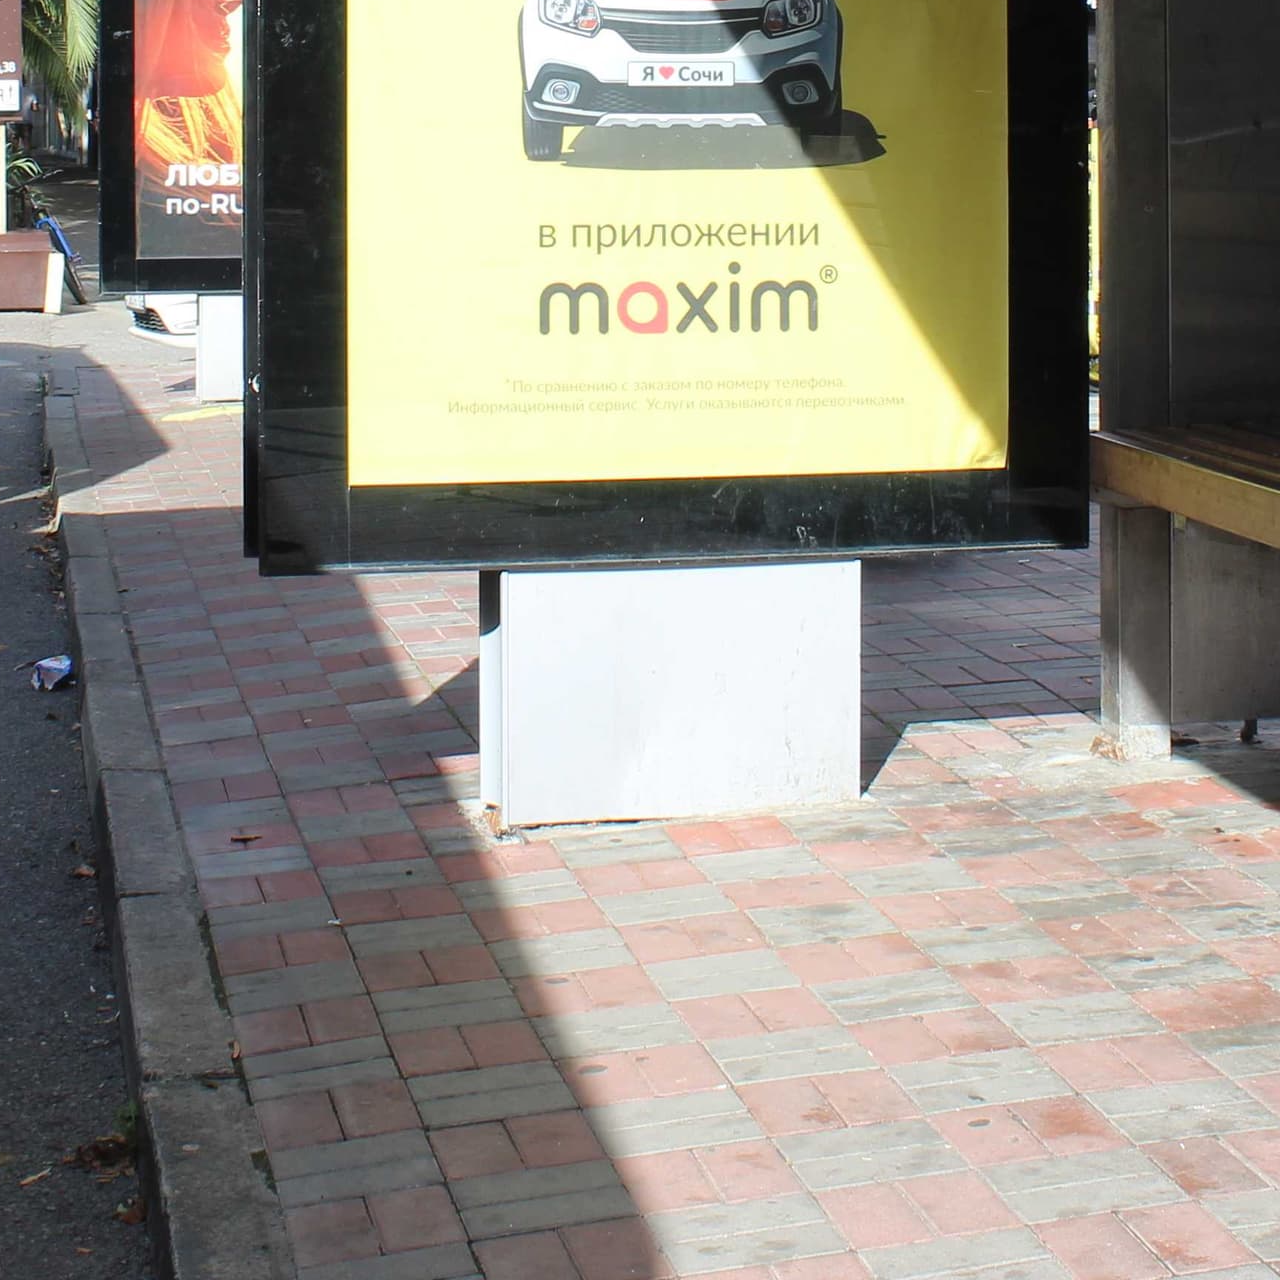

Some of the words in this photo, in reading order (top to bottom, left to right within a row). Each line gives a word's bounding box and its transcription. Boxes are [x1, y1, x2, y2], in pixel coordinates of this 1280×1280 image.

[641, 64, 655, 82] Я
[678, 64, 724, 85] Сочи
[165, 163, 243, 187] ЛЮБ
[538, 224, 557, 249] в
[571, 219, 821, 256] приложении
[536, 381, 618, 397] сравнению
[633, 379, 692, 392] заказом
[695, 379, 714, 391] по
[717, 377, 770, 393] номеру
[447, 398, 585, 416] Информационный
[645, 396, 695, 412] Услуги
[699, 396, 792, 410] оказываются
